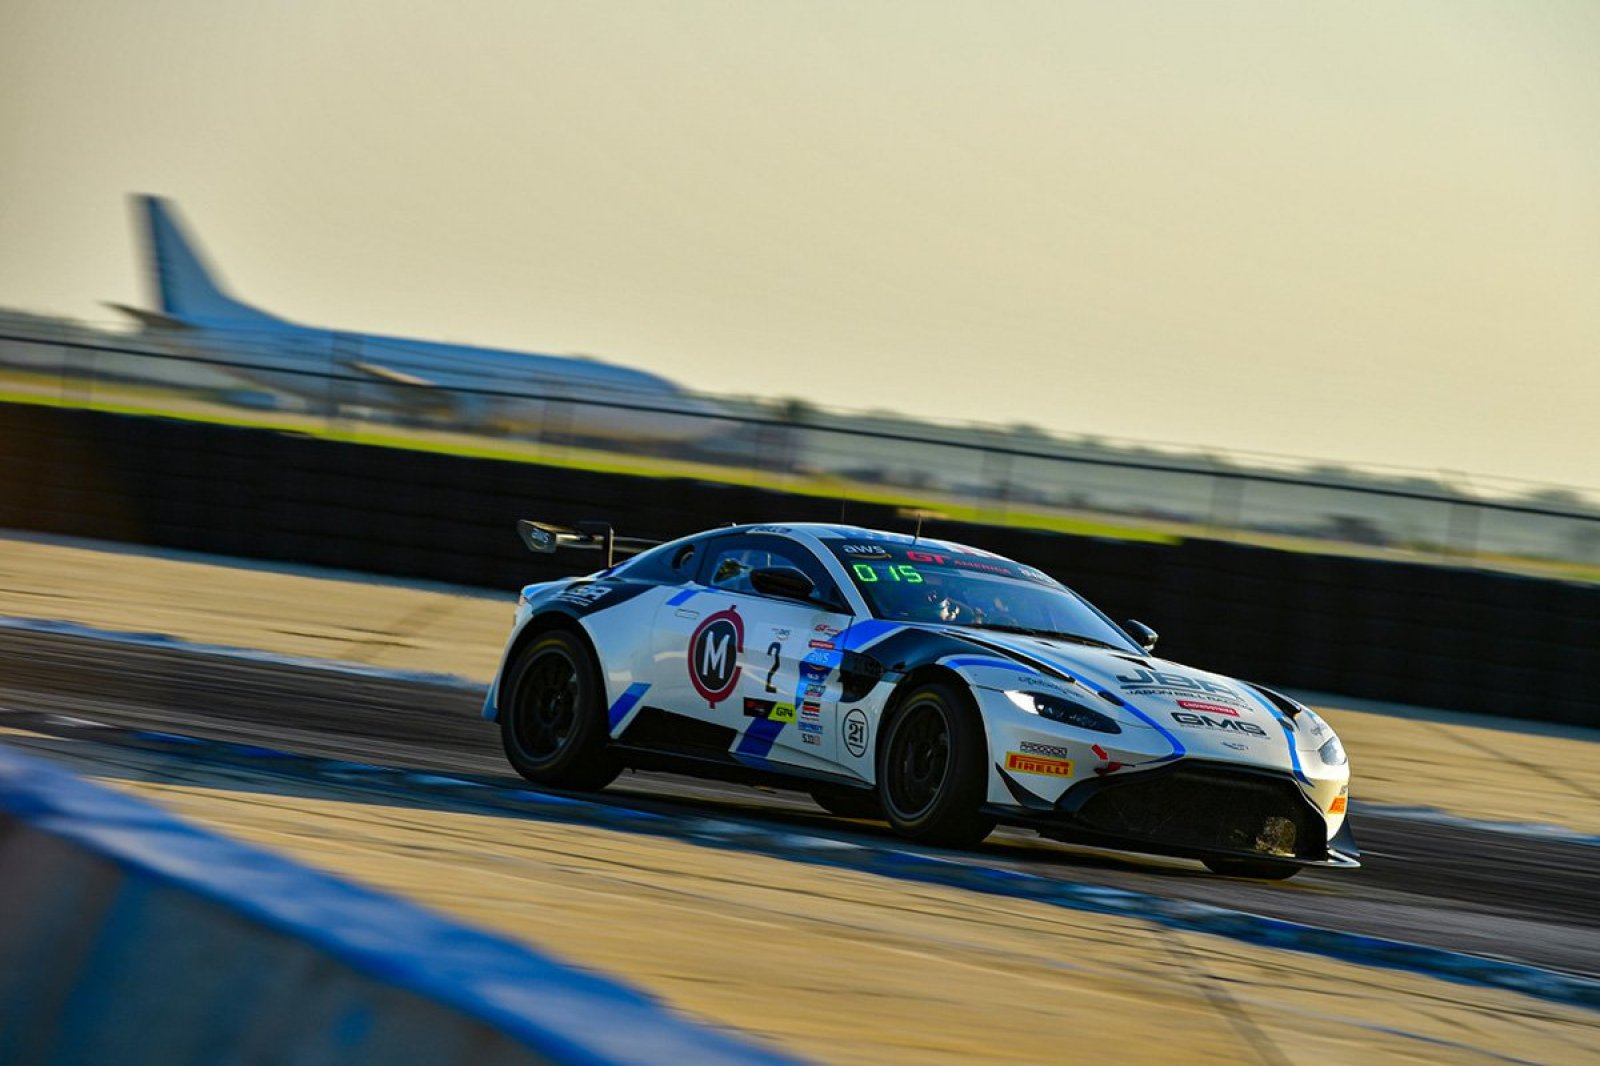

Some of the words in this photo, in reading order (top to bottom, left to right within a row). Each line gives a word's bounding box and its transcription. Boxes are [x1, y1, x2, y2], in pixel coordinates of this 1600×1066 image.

[843, 544, 886, 554] aws
[906, 551, 945, 564] GT
[703, 630, 731, 679] M
[765, 641, 781, 693] 2
[849, 722, 864, 743] 21
[1008, 754, 1071, 776] PIRELLI
